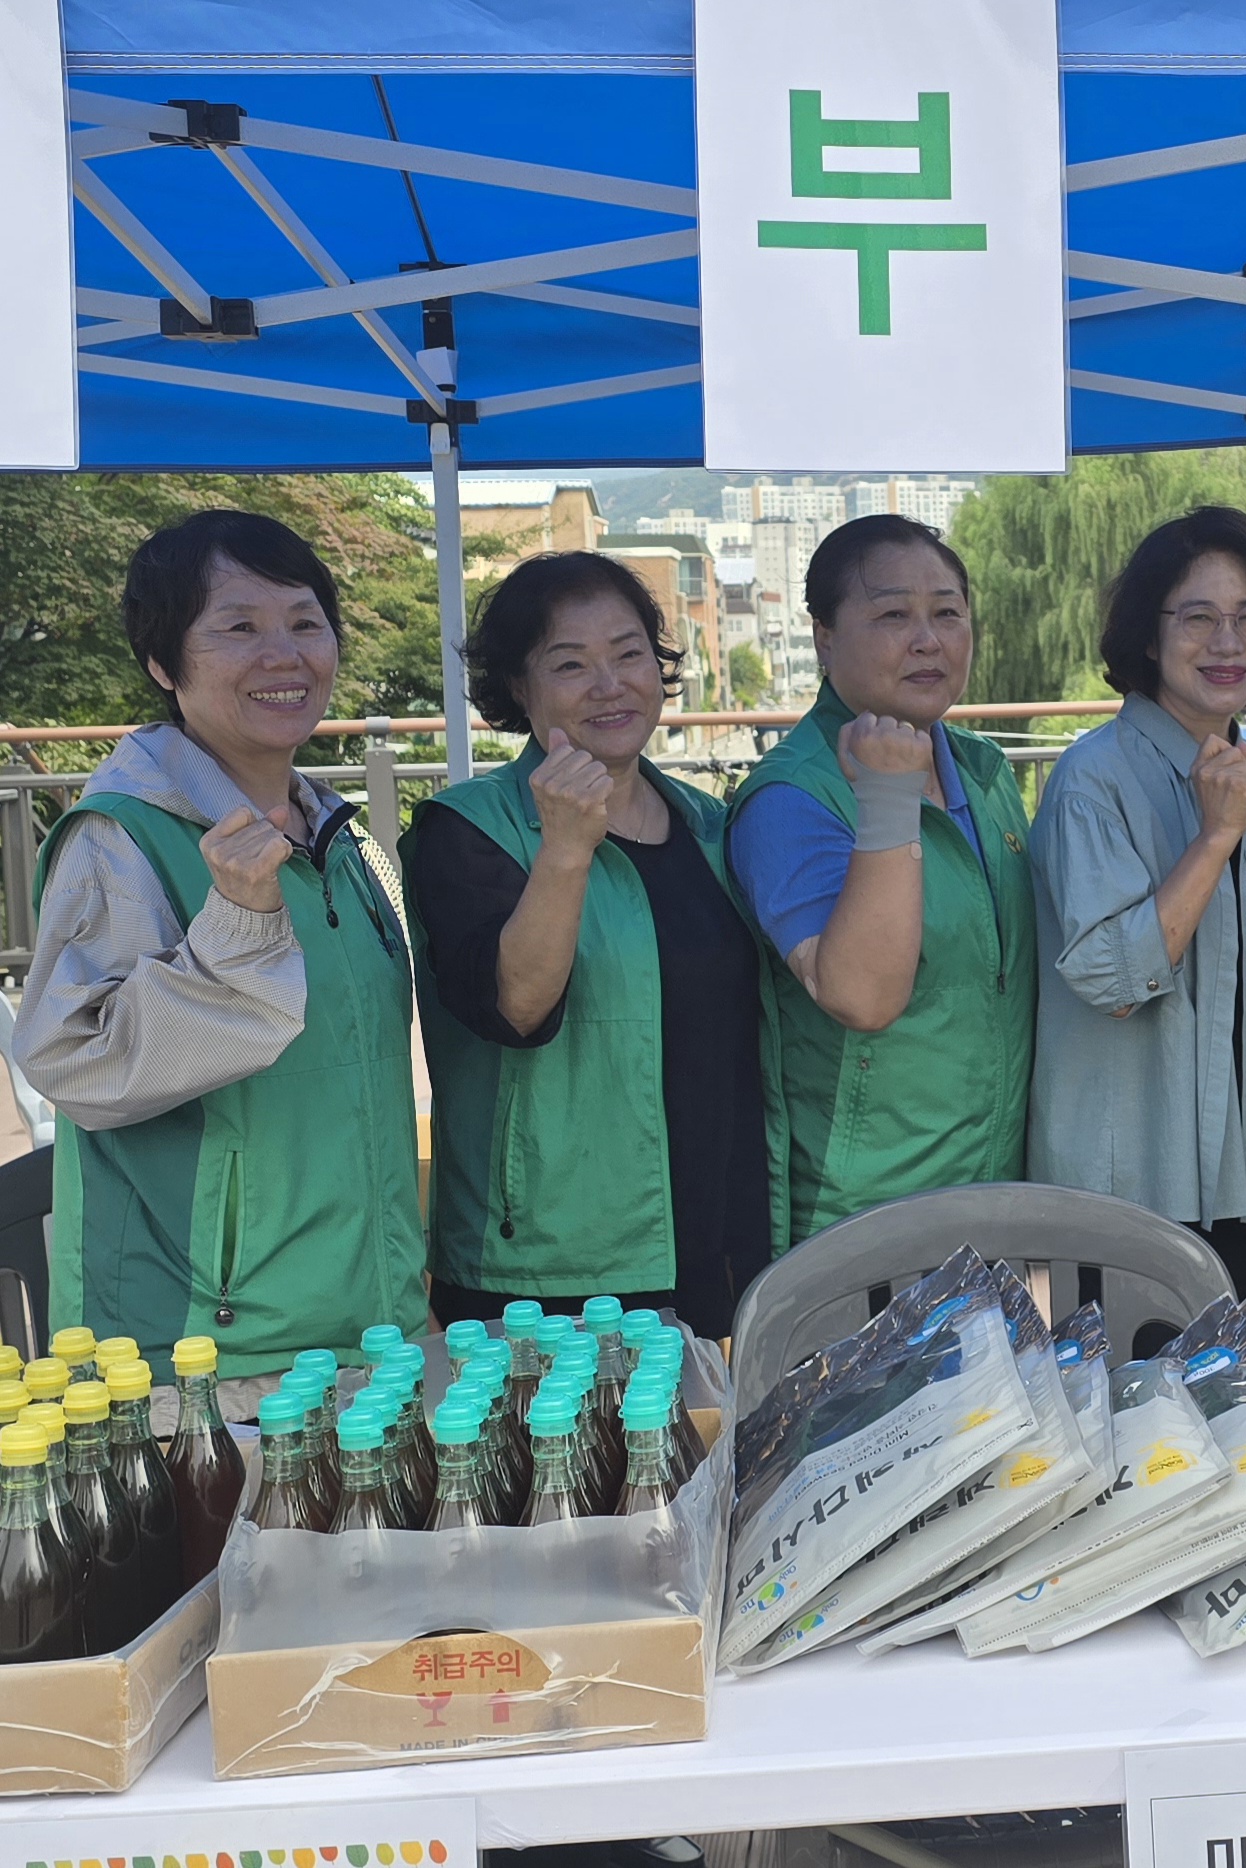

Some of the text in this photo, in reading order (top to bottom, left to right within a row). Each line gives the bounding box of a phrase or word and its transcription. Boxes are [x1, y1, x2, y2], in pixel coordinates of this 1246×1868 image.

[757, 89, 987, 335] 부
[412, 1649, 522, 1681] 취급주의
[400, 1740, 445, 1751] MADE
[452, 1738, 469, 1749] IN
